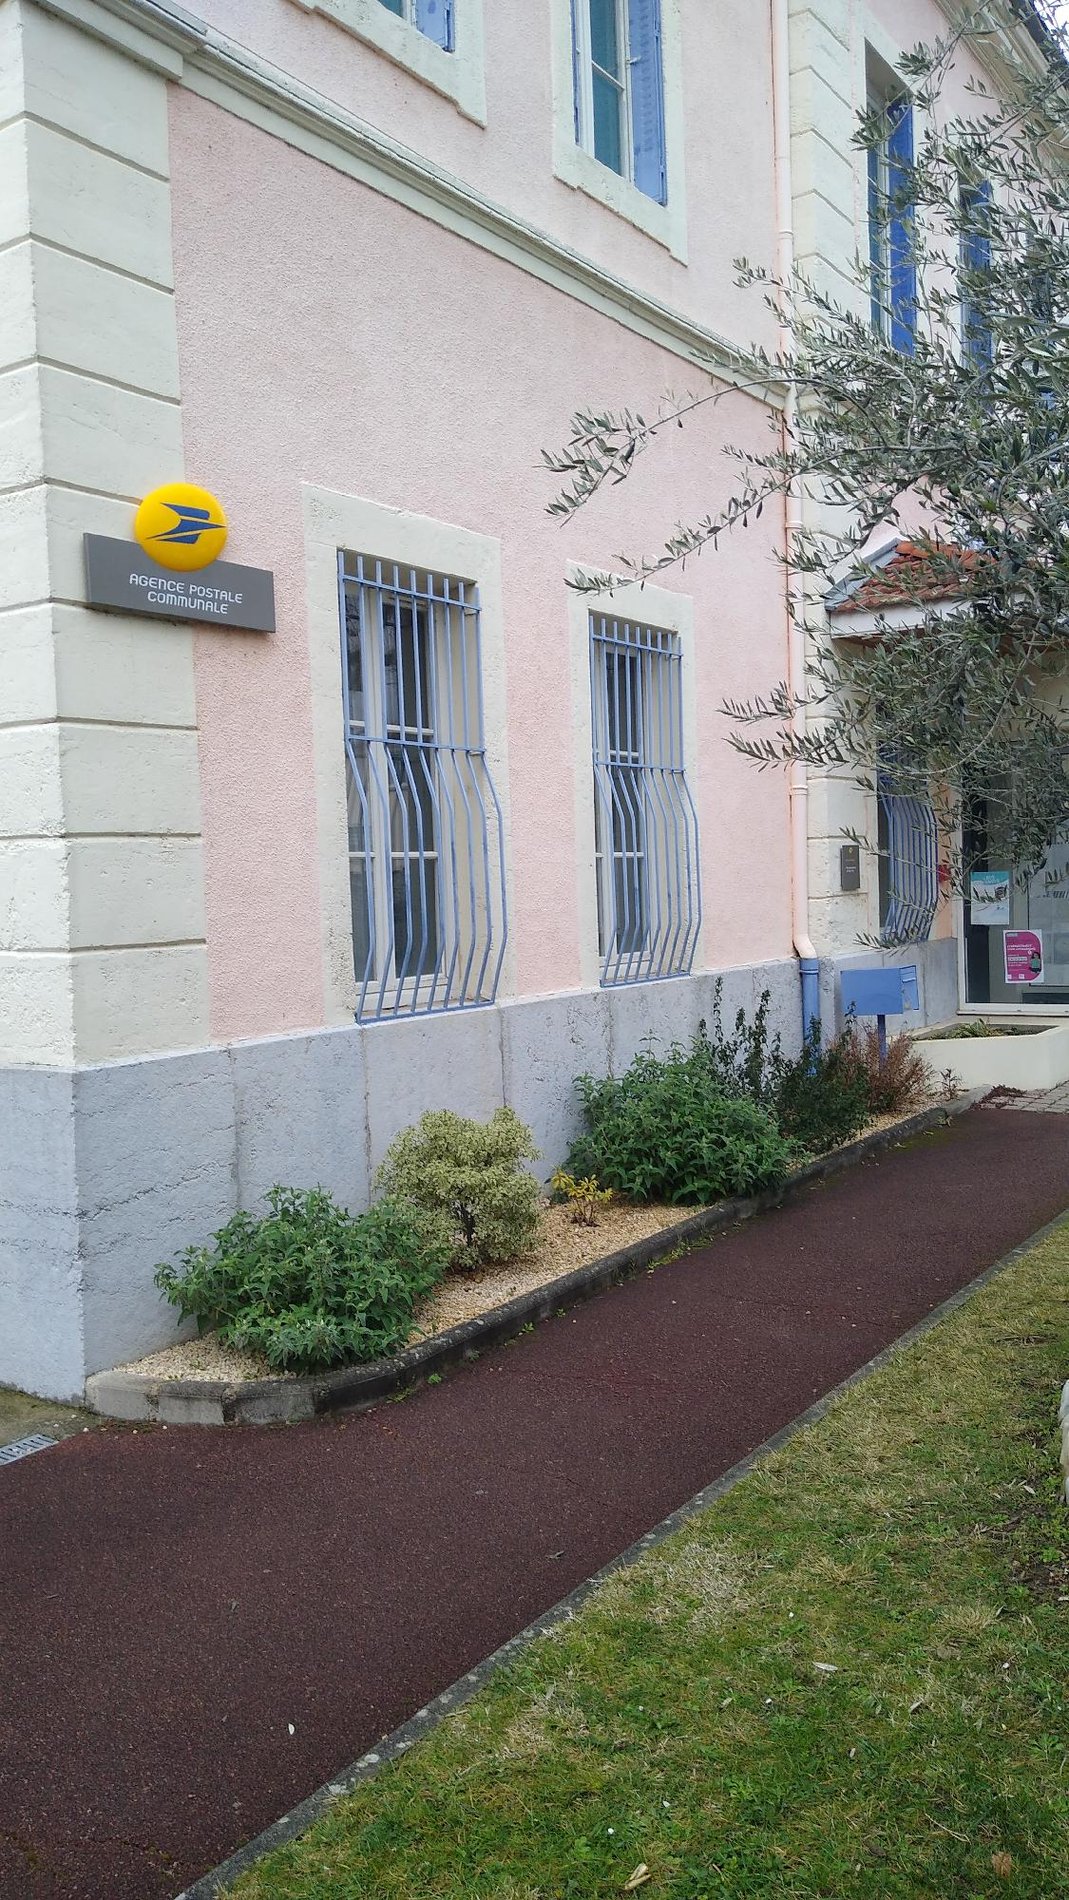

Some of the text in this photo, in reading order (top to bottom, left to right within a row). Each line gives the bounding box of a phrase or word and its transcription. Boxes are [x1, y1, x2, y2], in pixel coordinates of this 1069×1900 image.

[129, 573, 243, 604] AGENCE POSTALE
[147, 591, 229, 614] COMMUNALE
